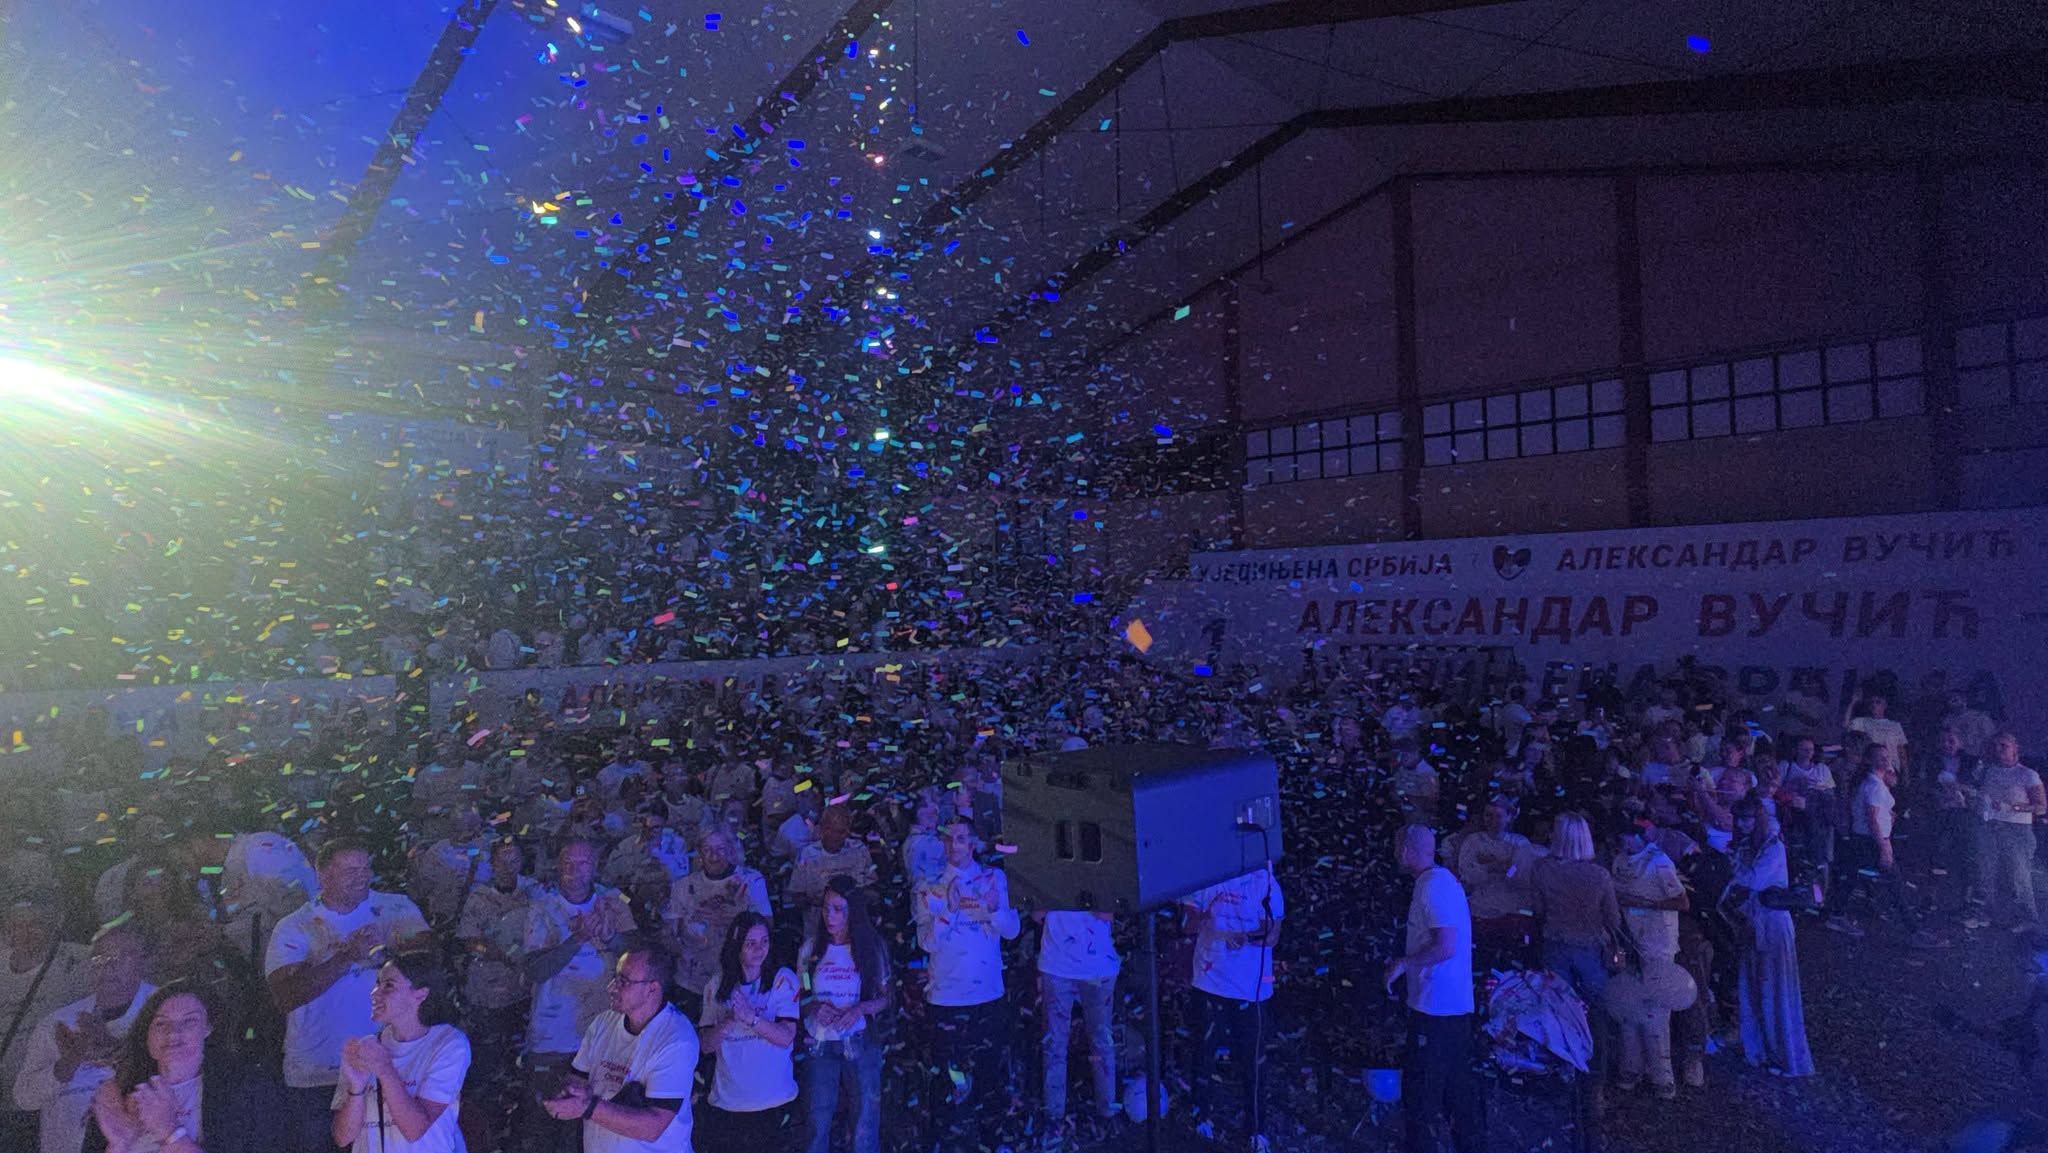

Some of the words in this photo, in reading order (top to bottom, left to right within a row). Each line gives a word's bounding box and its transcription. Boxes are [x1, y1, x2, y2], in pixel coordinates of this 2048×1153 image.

[1347, 553, 1453, 577] СРБИЈА
[1556, 537, 1818, 572] АЛЕКСАНДАР
[1842, 527, 2016, 562] ВУЧИЋ
[1296, 594, 1659, 645] АЛЕКСАНДАР
[1697, 589, 1980, 639] ВУЧИЋ
